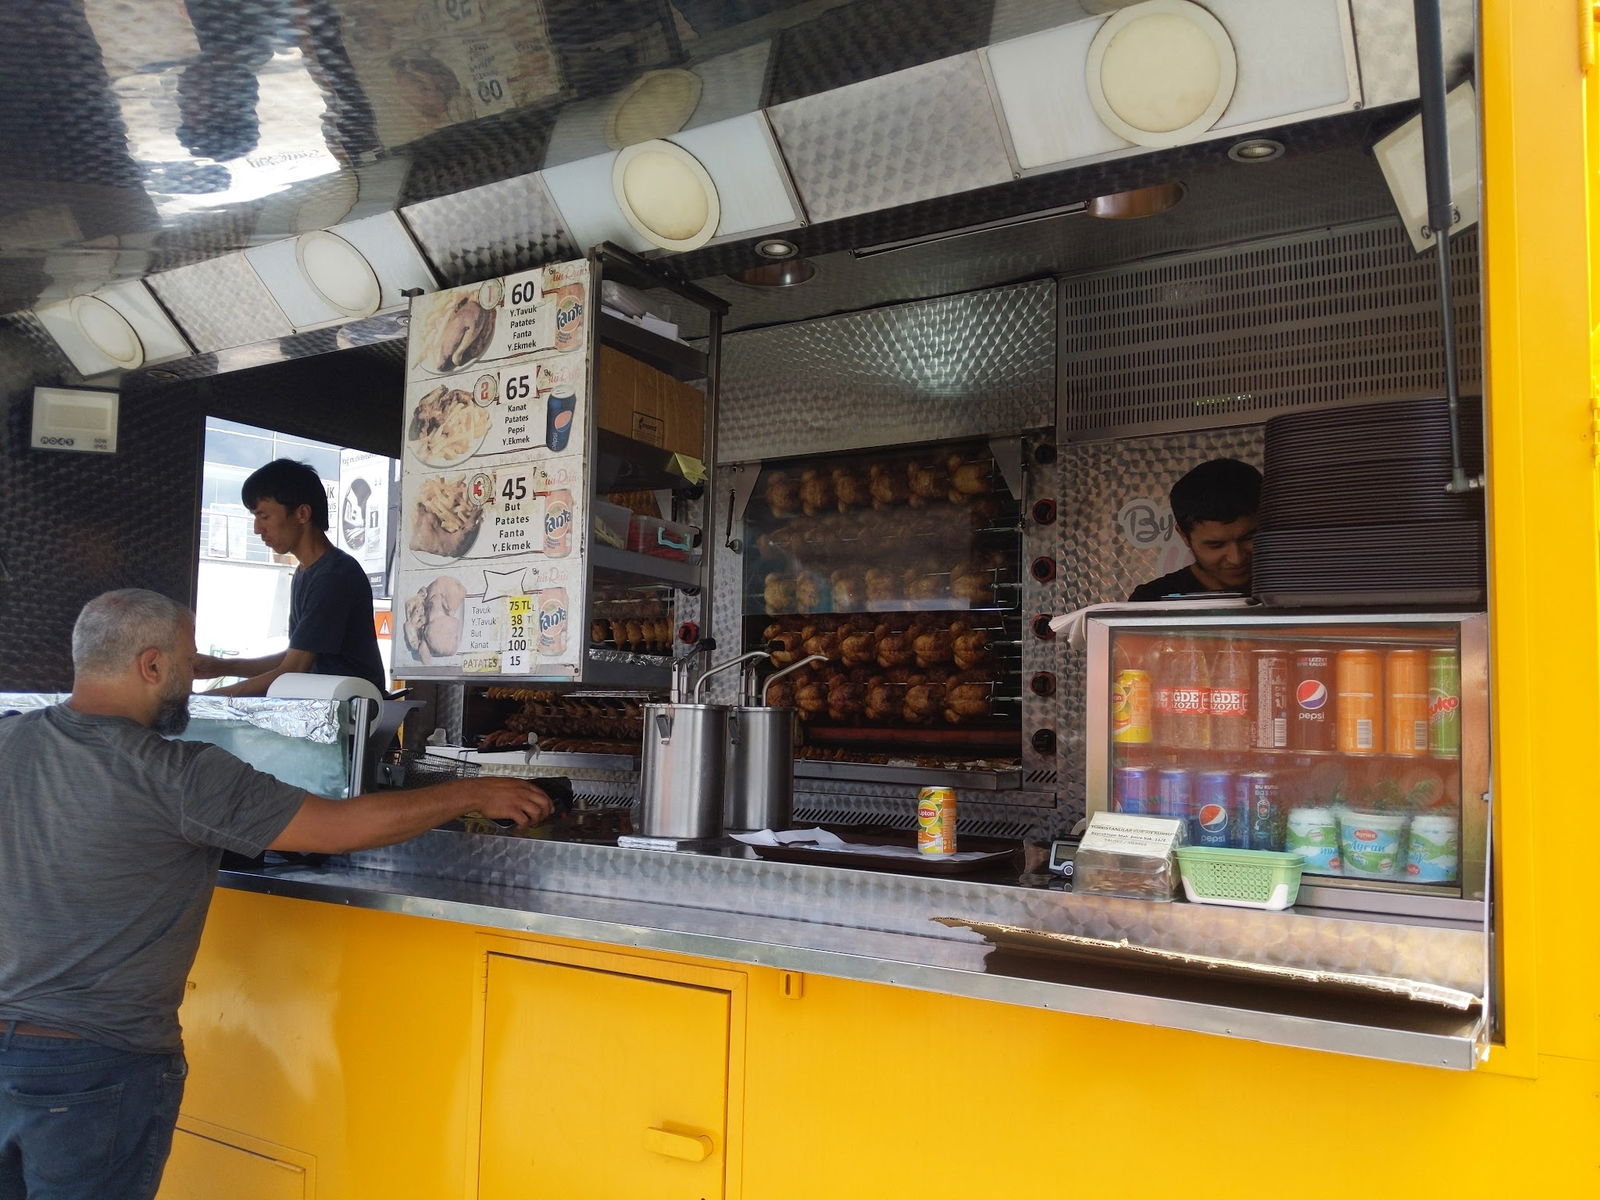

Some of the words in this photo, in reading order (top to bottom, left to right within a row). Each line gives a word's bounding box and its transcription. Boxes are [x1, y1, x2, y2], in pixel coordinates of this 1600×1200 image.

[511, 280, 535, 305] 60
[510, 305, 537, 317] Y.Tavuk
[510, 318, 536, 328] Patates
[513, 330, 532, 340] Fanta
[507, 341, 537, 352] Y.Ekmek
[480, 382, 489, 400] 2
[506, 375, 530, 400] 65
[507, 403, 527, 412] Kanat
[505, 414, 529, 424] Patates
[508, 425, 525, 435] Pepsi
[502, 435, 530, 446] Y.Ekmek
[501, 476, 527, 501] 45
[504, 502, 521, 512] But
[495, 516, 530, 526] Patates
[1124, 505, 1174, 542] By
[499, 529, 525, 538] Fanta
[492, 541, 531, 552] Y.Ekmek
[472, 606, 491, 614] Tavuk
[509, 601, 520, 611] 75
[521, 600, 531, 610] TL
[471, 617, 497, 626] Y.Tavuk
[511, 615, 523, 626] 38
[470, 629, 482, 637] But
[511, 627, 524, 638] 22
[470, 641, 489, 649] Kanat
[508, 640, 527, 651] 100
[463, 658, 498, 668] PATATES
[510, 656, 521, 666] 15
[1299, 712, 1325, 720] pepsi
[1201, 835, 1226, 843] pepsi
